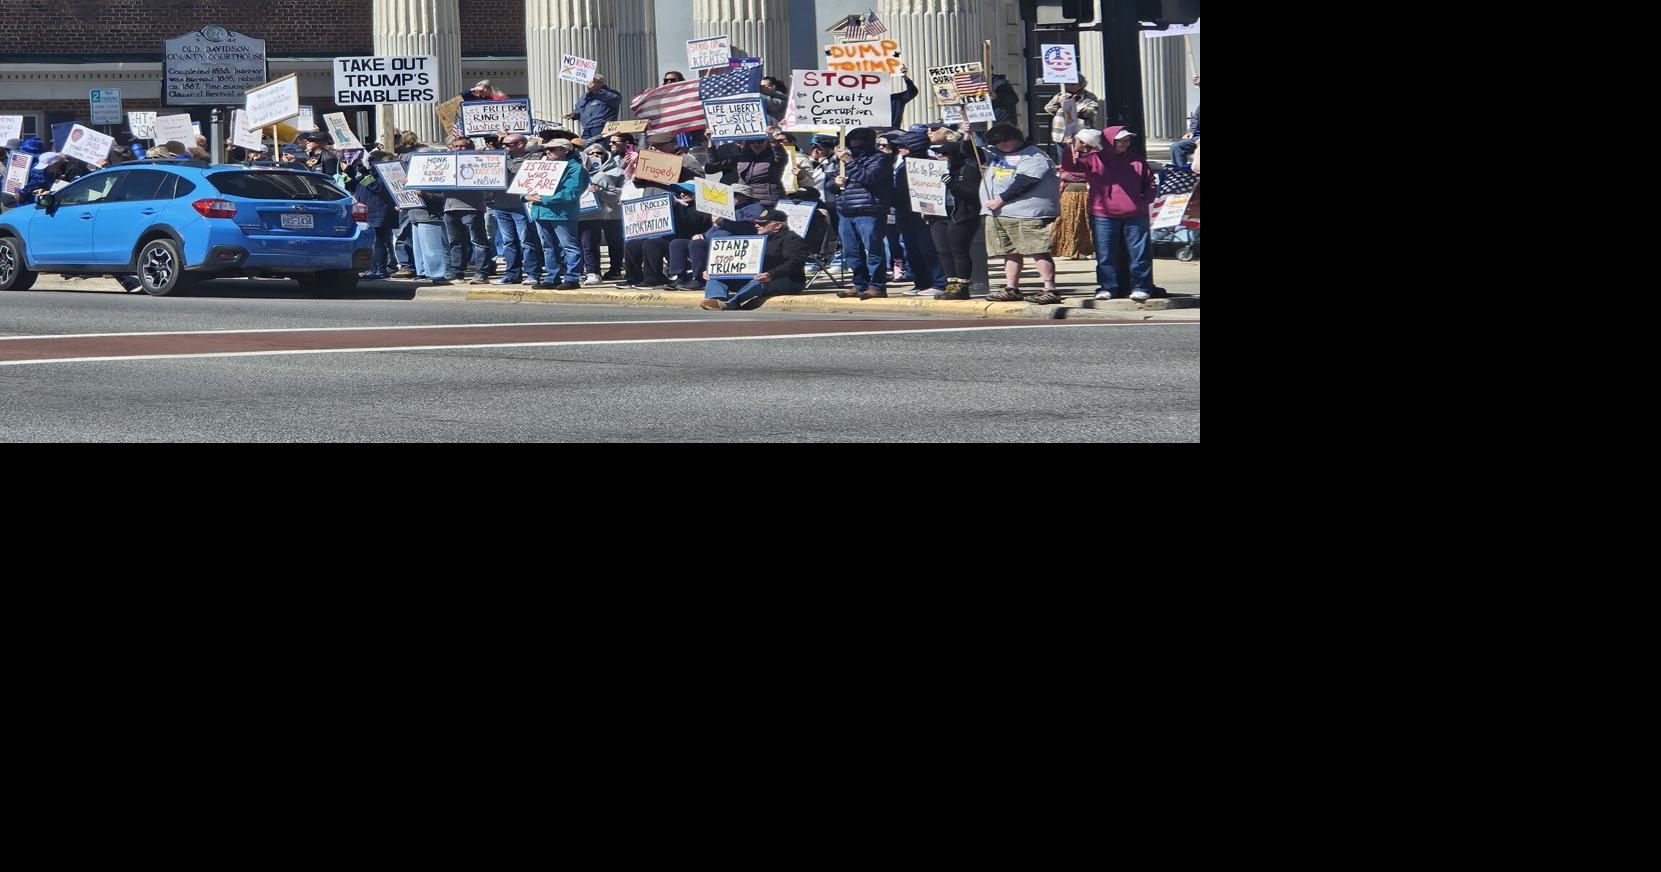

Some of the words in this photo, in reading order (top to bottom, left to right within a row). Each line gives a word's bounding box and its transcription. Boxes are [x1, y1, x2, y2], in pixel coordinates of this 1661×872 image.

[830, 40, 897, 58] DUMP
[339, 58, 384, 72] TAKE
[391, 58, 427, 71] OUT
[563, 56, 575, 65] NO
[576, 58, 596, 69] KINGS
[692, 53, 726, 66] RIGHTS
[929, 65, 966, 76] PROTECT
[345, 73, 429, 87] TRUMP'S
[804, 72, 882, 89] STOP
[338, 88, 434, 103] ENABLERS
[812, 90, 873, 105] Cruelty
[707, 105, 725, 114] LIFE
[729, 103, 760, 113] LIBERTY
[811, 105, 873, 116] Corruption
[467, 122, 500, 131] Justice
[813, 117, 861, 125] Fascism
[524, 162, 536, 171] IS
[537, 162, 559, 171] THIS
[640, 158, 676, 180] Tragedy
[517, 179, 533, 188] WE
[534, 179, 556, 189] ARE
[911, 178, 941, 188] Demand
[910, 188, 943, 205] Democracy
[624, 204, 636, 213] DUE
[640, 199, 668, 210] PROCESS
[626, 216, 669, 234] DEPORTATION
[713, 240, 749, 251] STAND
[710, 263, 746, 273] TRUMP
